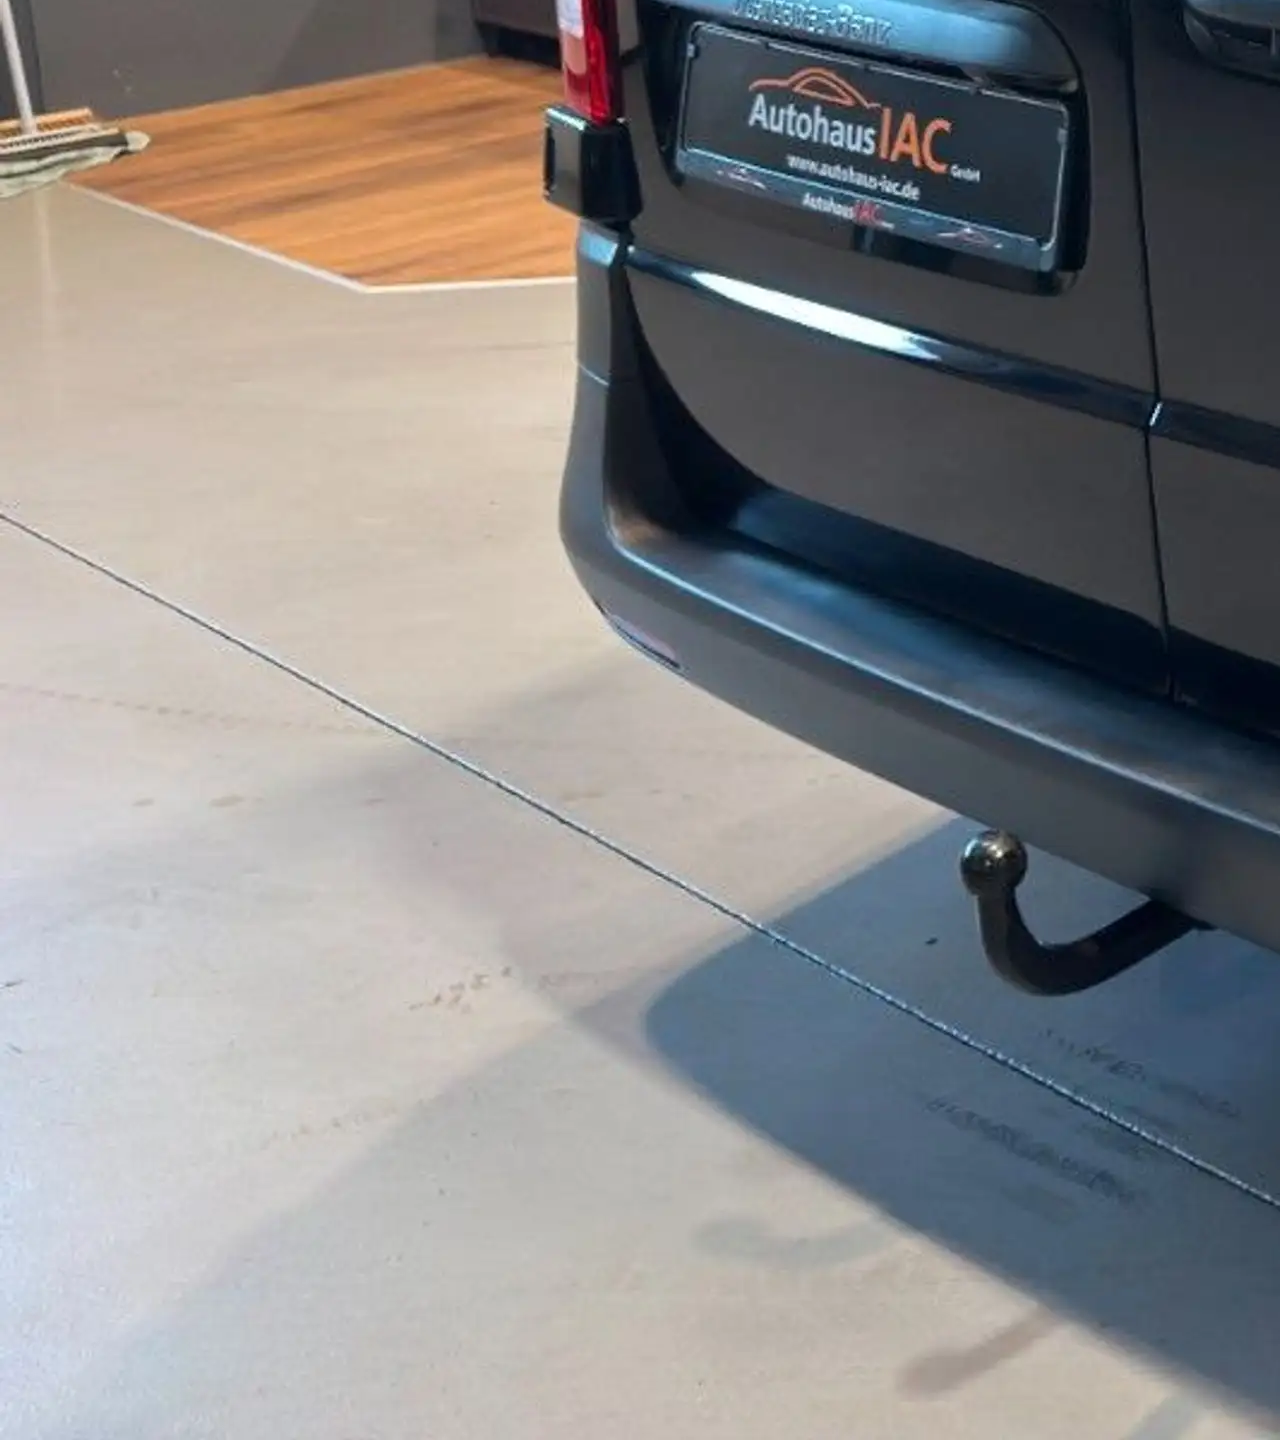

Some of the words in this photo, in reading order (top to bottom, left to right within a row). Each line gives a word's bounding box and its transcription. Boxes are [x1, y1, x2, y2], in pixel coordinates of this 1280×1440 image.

[749, 93, 876, 155] Autohaus
[879, 107, 952, 174] IAC
[786, 154, 920, 201] www.autohaus-iac.de
